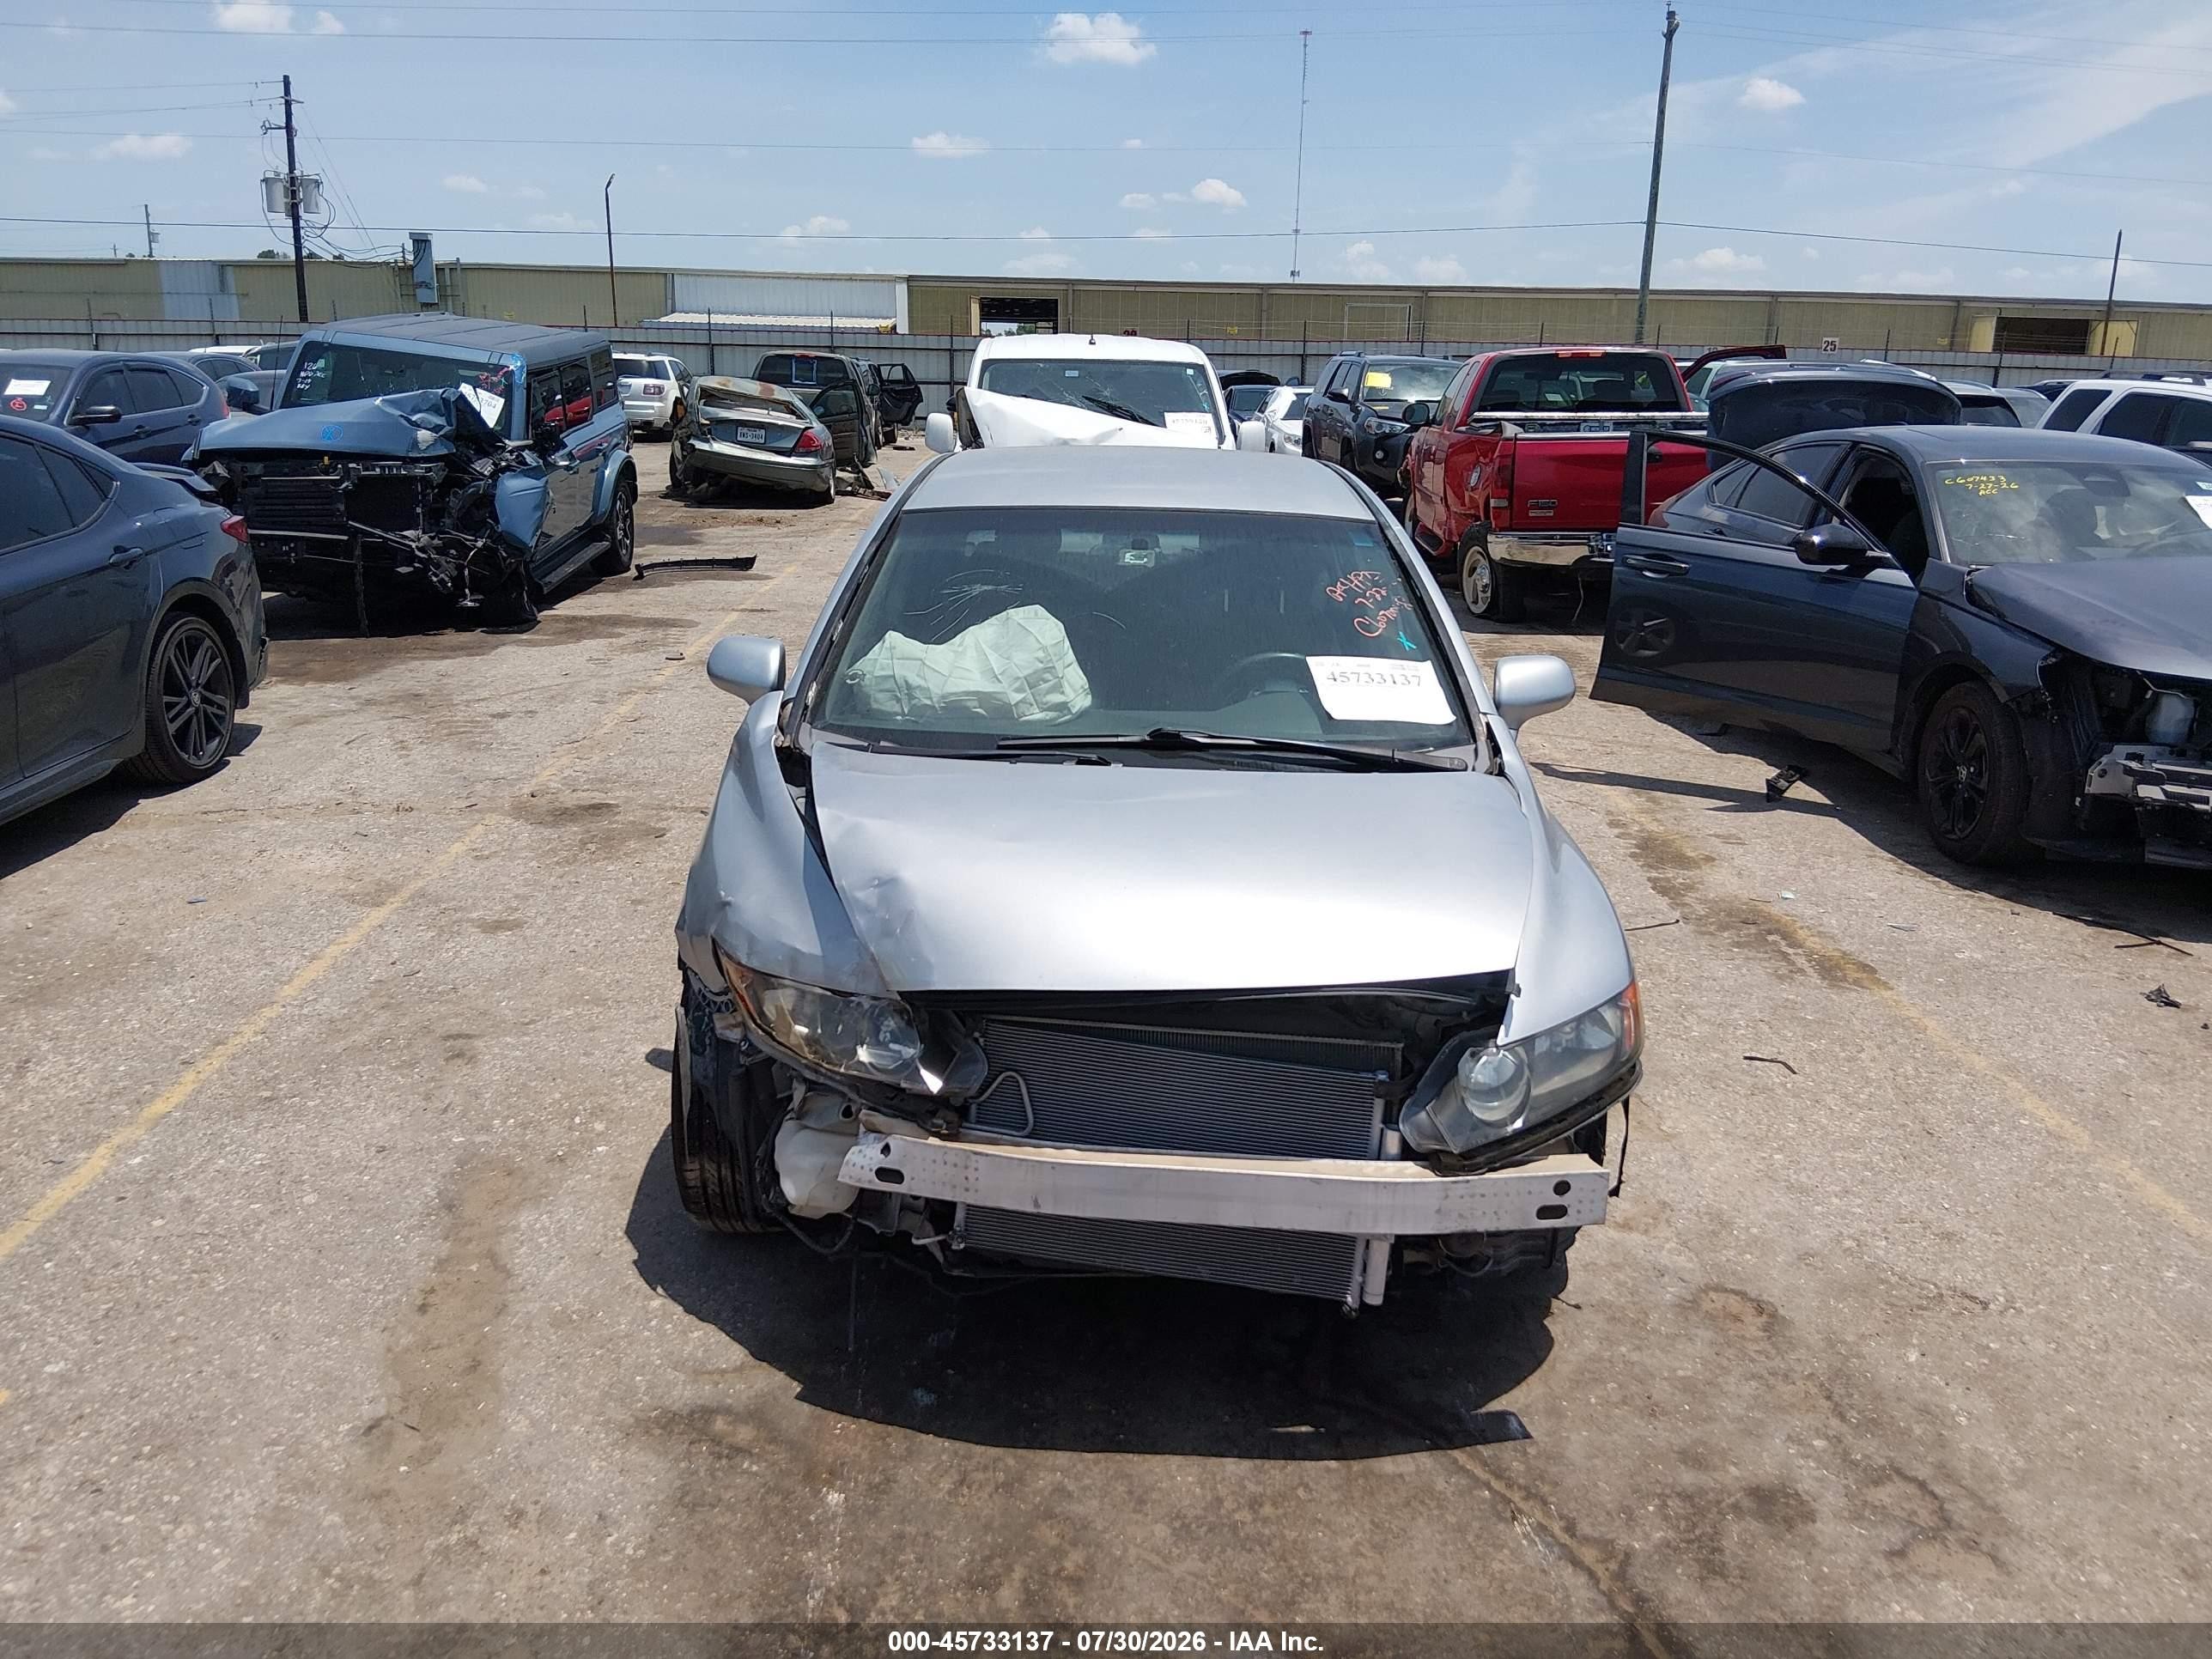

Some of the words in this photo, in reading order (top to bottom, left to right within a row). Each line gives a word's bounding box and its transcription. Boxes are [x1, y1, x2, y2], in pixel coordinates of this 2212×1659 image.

[1823, 340, 1837, 351] 25
[1965, 482, 2020, 490] 7-27-26
[1978, 488, 1998, 496] ACC
[1327, 671, 1421, 687] 45733137
